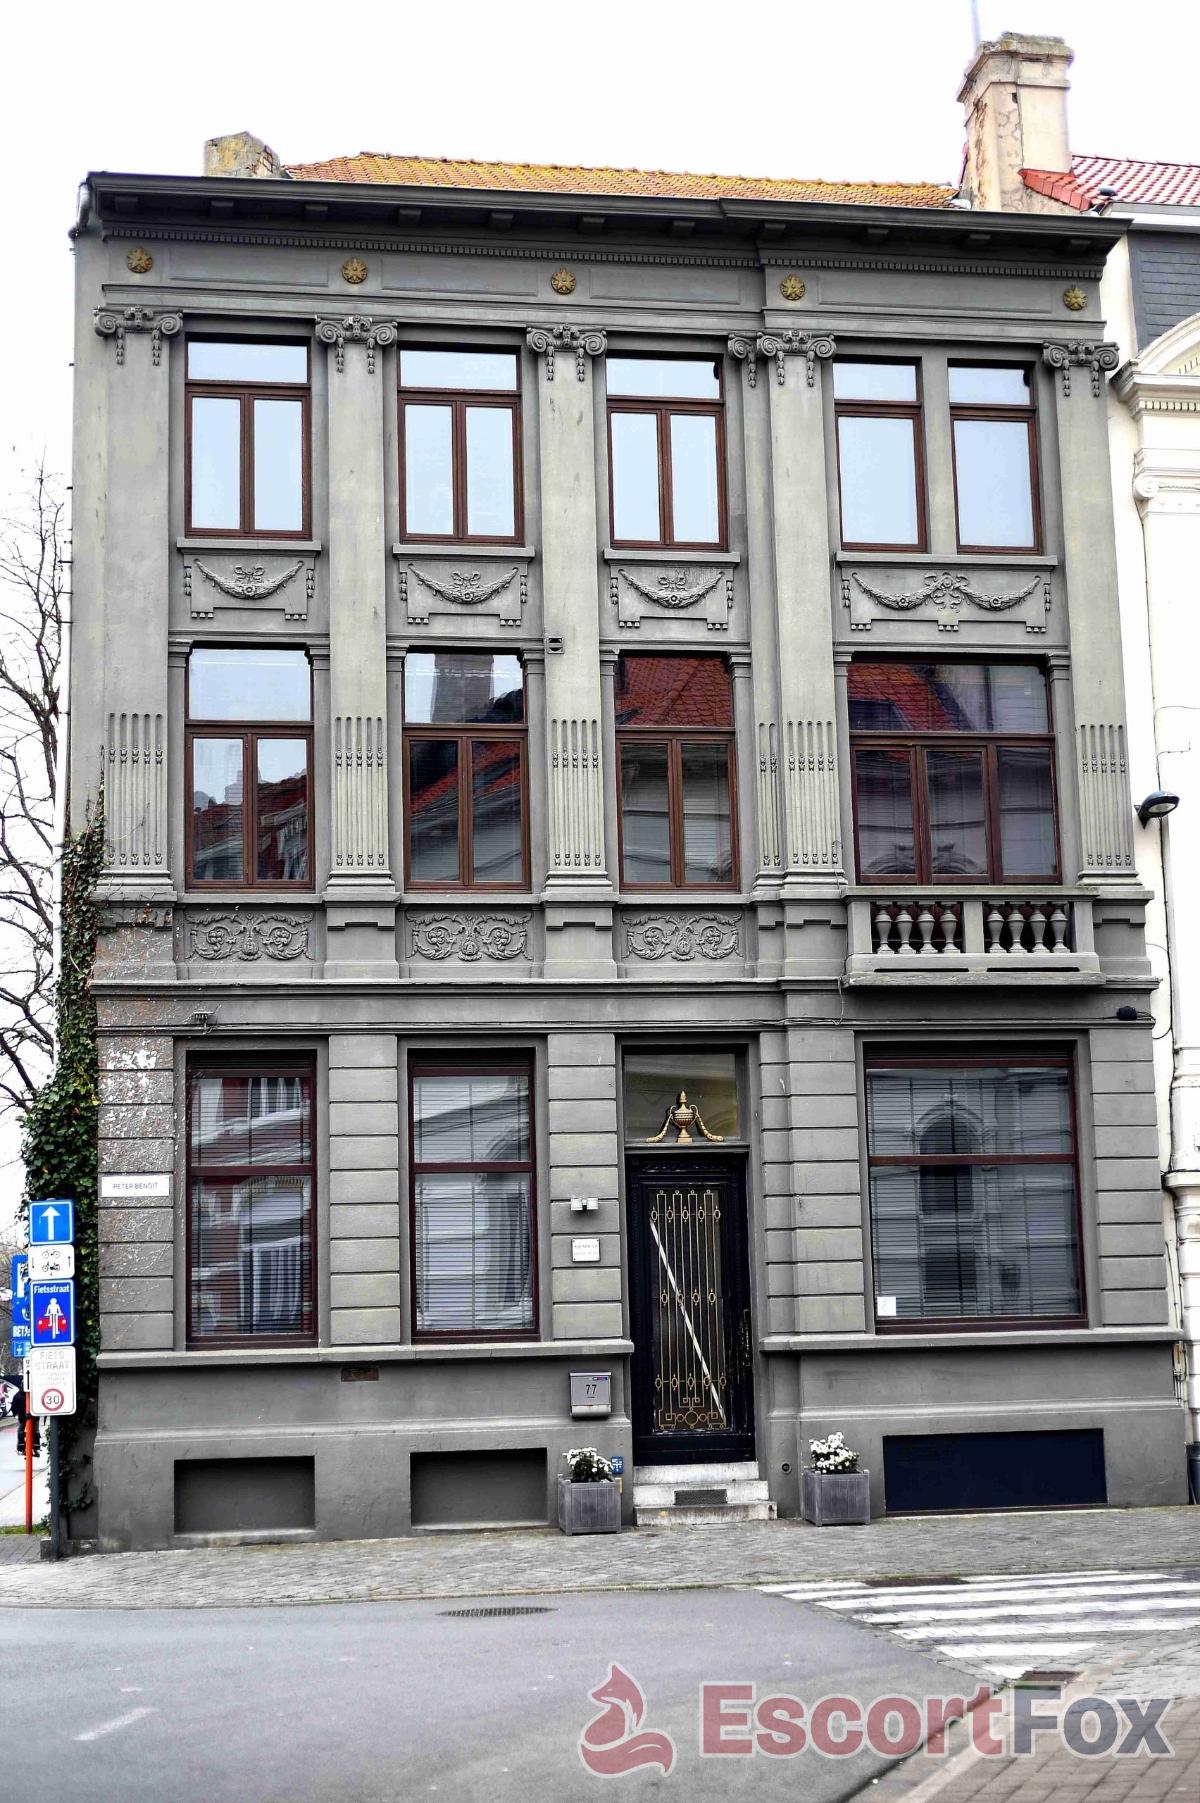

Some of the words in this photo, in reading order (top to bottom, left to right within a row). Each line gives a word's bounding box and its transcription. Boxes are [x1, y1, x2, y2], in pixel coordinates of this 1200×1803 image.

[135, 1182, 158, 1190] BENOIT
[34, 1285, 70, 1294] Fietsstraat
[39, 1351, 65, 1360] FIETS
[35, 1361, 70, 1370] STRAAT
[586, 1384, 597, 1395] 77
[46, 1395, 60, 1405] 30
